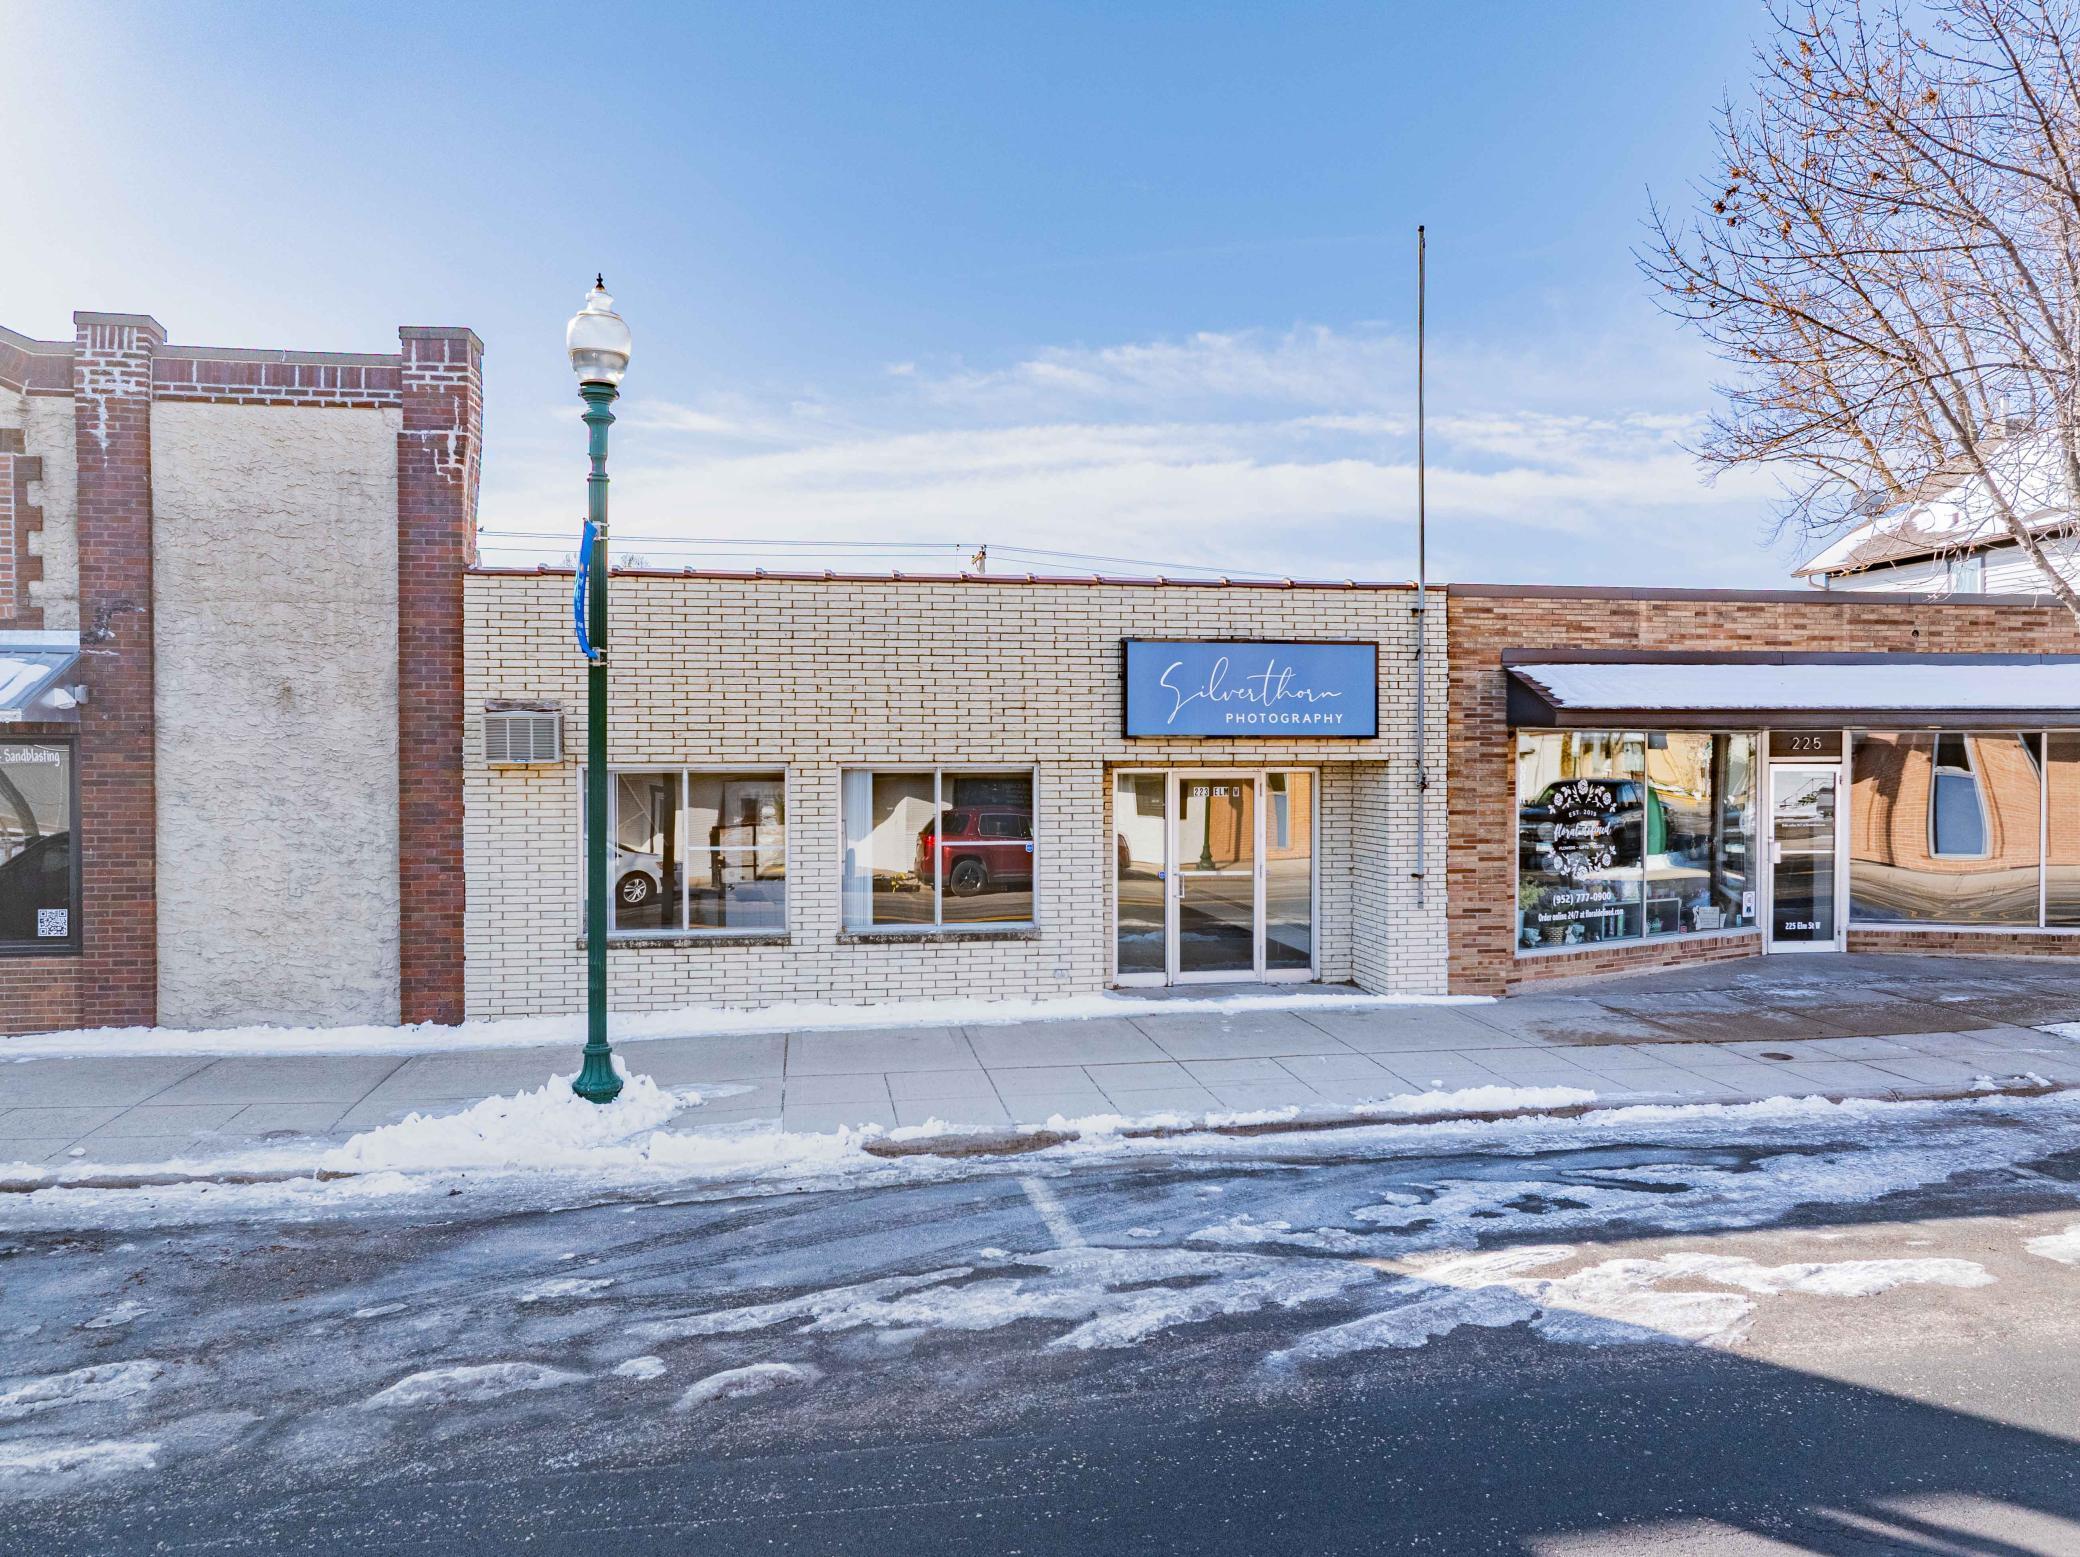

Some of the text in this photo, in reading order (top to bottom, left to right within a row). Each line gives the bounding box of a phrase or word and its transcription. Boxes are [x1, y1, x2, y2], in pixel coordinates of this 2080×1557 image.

[1160, 656, 1342, 724] Silverthorn
[1225, 712, 1344, 724] PHOTOGRAPHY
[1791, 736, 1822, 750] 225
[3, 748, 61, 767] Sandblasting
[1194, 787, 1239, 796] 223 ELM W
[1552, 891, 1612, 907] (952) 777-0900
[1538, 912, 1552, 922] Order
[1552, 911, 1567, 921] online
[1567, 910, 1579, 920] 24/7
[1579, 910, 1585, 918] at
[1785, 922, 1796, 930] 225
[1797, 921, 1807, 930] Elm
[1808, 921, 1815, 930] St
